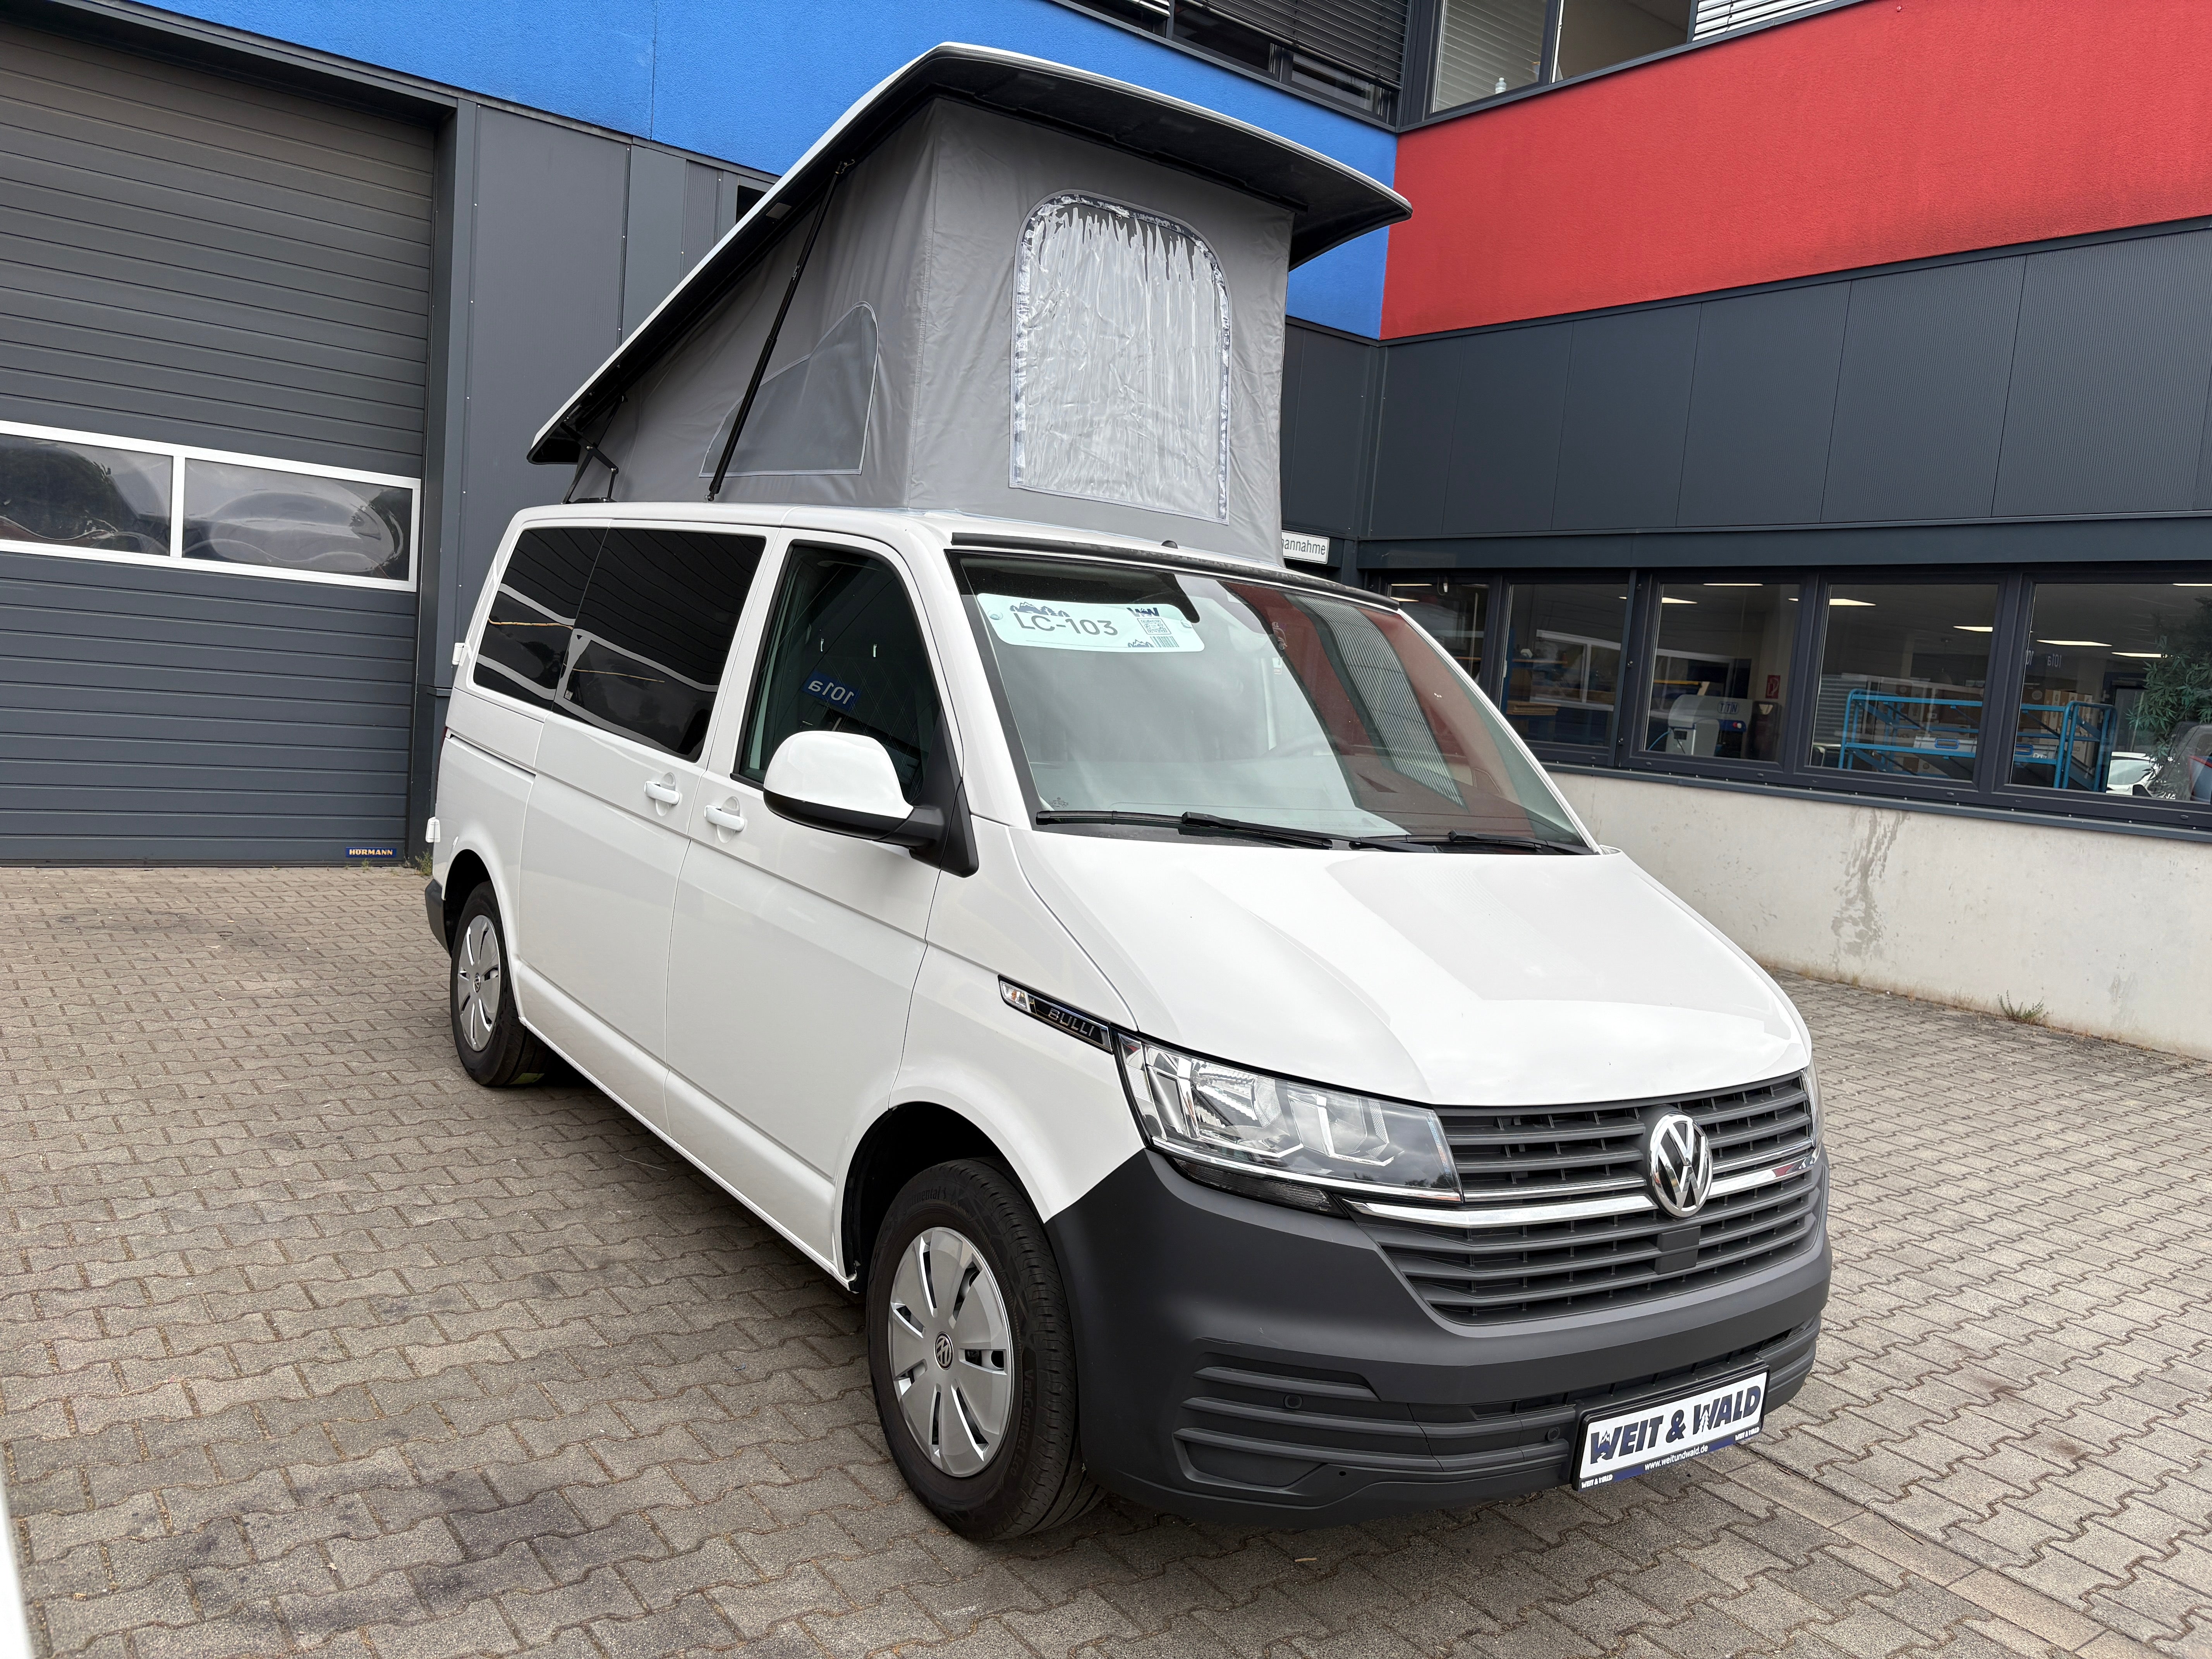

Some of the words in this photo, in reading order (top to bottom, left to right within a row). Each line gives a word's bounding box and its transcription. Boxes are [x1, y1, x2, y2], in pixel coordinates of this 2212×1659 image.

[1013, 613, 1118, 635] LC-103
[1048, 1008, 1095, 1036] BULLI
[1590, 1415, 1664, 1465] WEIT
[1666, 1409, 1686, 1443] &
[1692, 1385, 1761, 1435] WALD
[1644, 1444, 1709, 1471] www.weitundwald.de
[1581, 1479, 1594, 1489] WEIT
